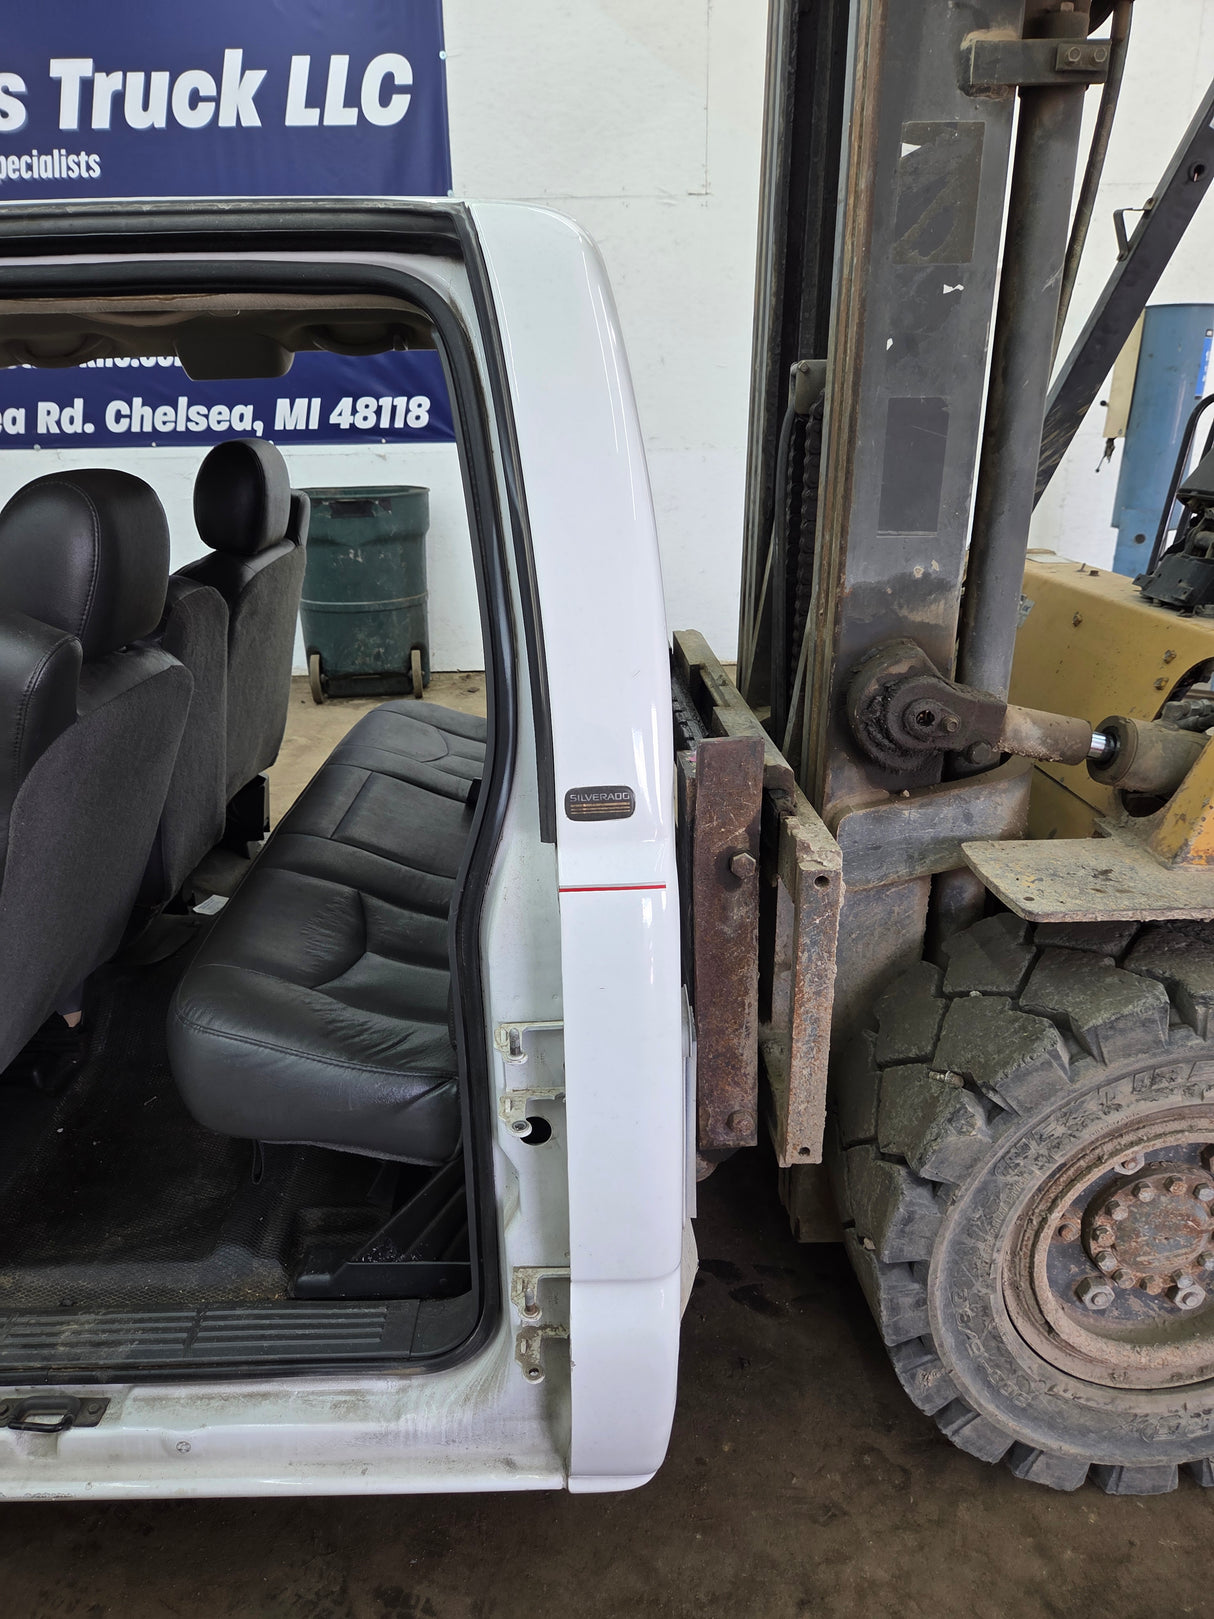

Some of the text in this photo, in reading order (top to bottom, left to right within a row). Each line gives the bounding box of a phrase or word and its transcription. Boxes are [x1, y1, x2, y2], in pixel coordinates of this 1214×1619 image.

[49, 48, 267, 130] Truck
[285, 53, 414, 127] LLC
[37, 398, 95, 434] Rd.
[105, 396, 264, 436] Chelsea,
[274, 397, 321, 431] MI
[329, 396, 431, 429] 48118
[569, 791, 631, 803] SILVERADO
